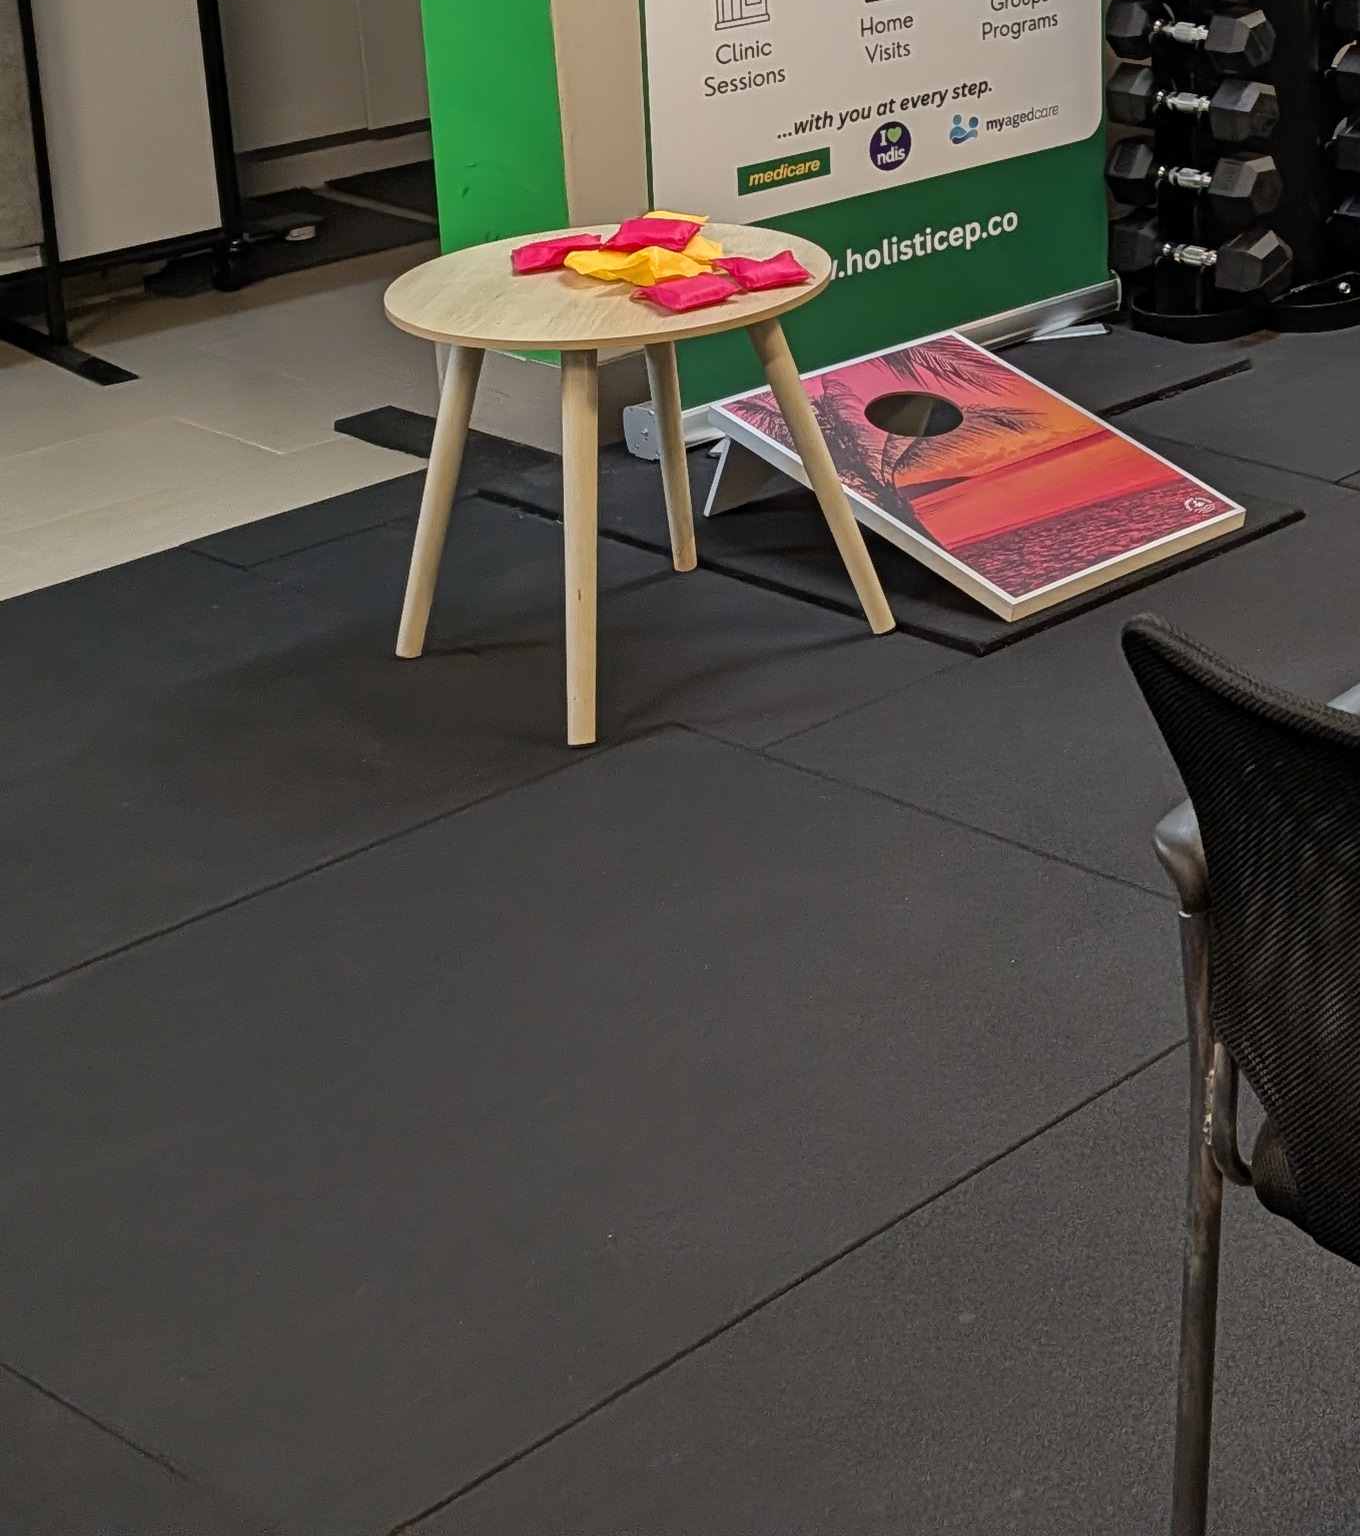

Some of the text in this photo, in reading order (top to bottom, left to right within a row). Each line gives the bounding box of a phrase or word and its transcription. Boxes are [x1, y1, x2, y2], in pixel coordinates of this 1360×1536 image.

[860, 13, 914, 37] Home
[982, 13, 1058, 41] Programs
[716, 40, 773, 65] Clinic
[865, 40, 911, 64] Visits
[704, 66, 786, 97] Sessions
[837, 105, 872, 131] you
[876, 98, 896, 118] at
[899, 88, 949, 114] every
[951, 78, 993, 101] step.
[986, 102, 1059, 132] myagedcare
[880, 129, 888, 147] I
[877, 145, 906, 166] ndis
[748, 157, 821, 187] medicare
